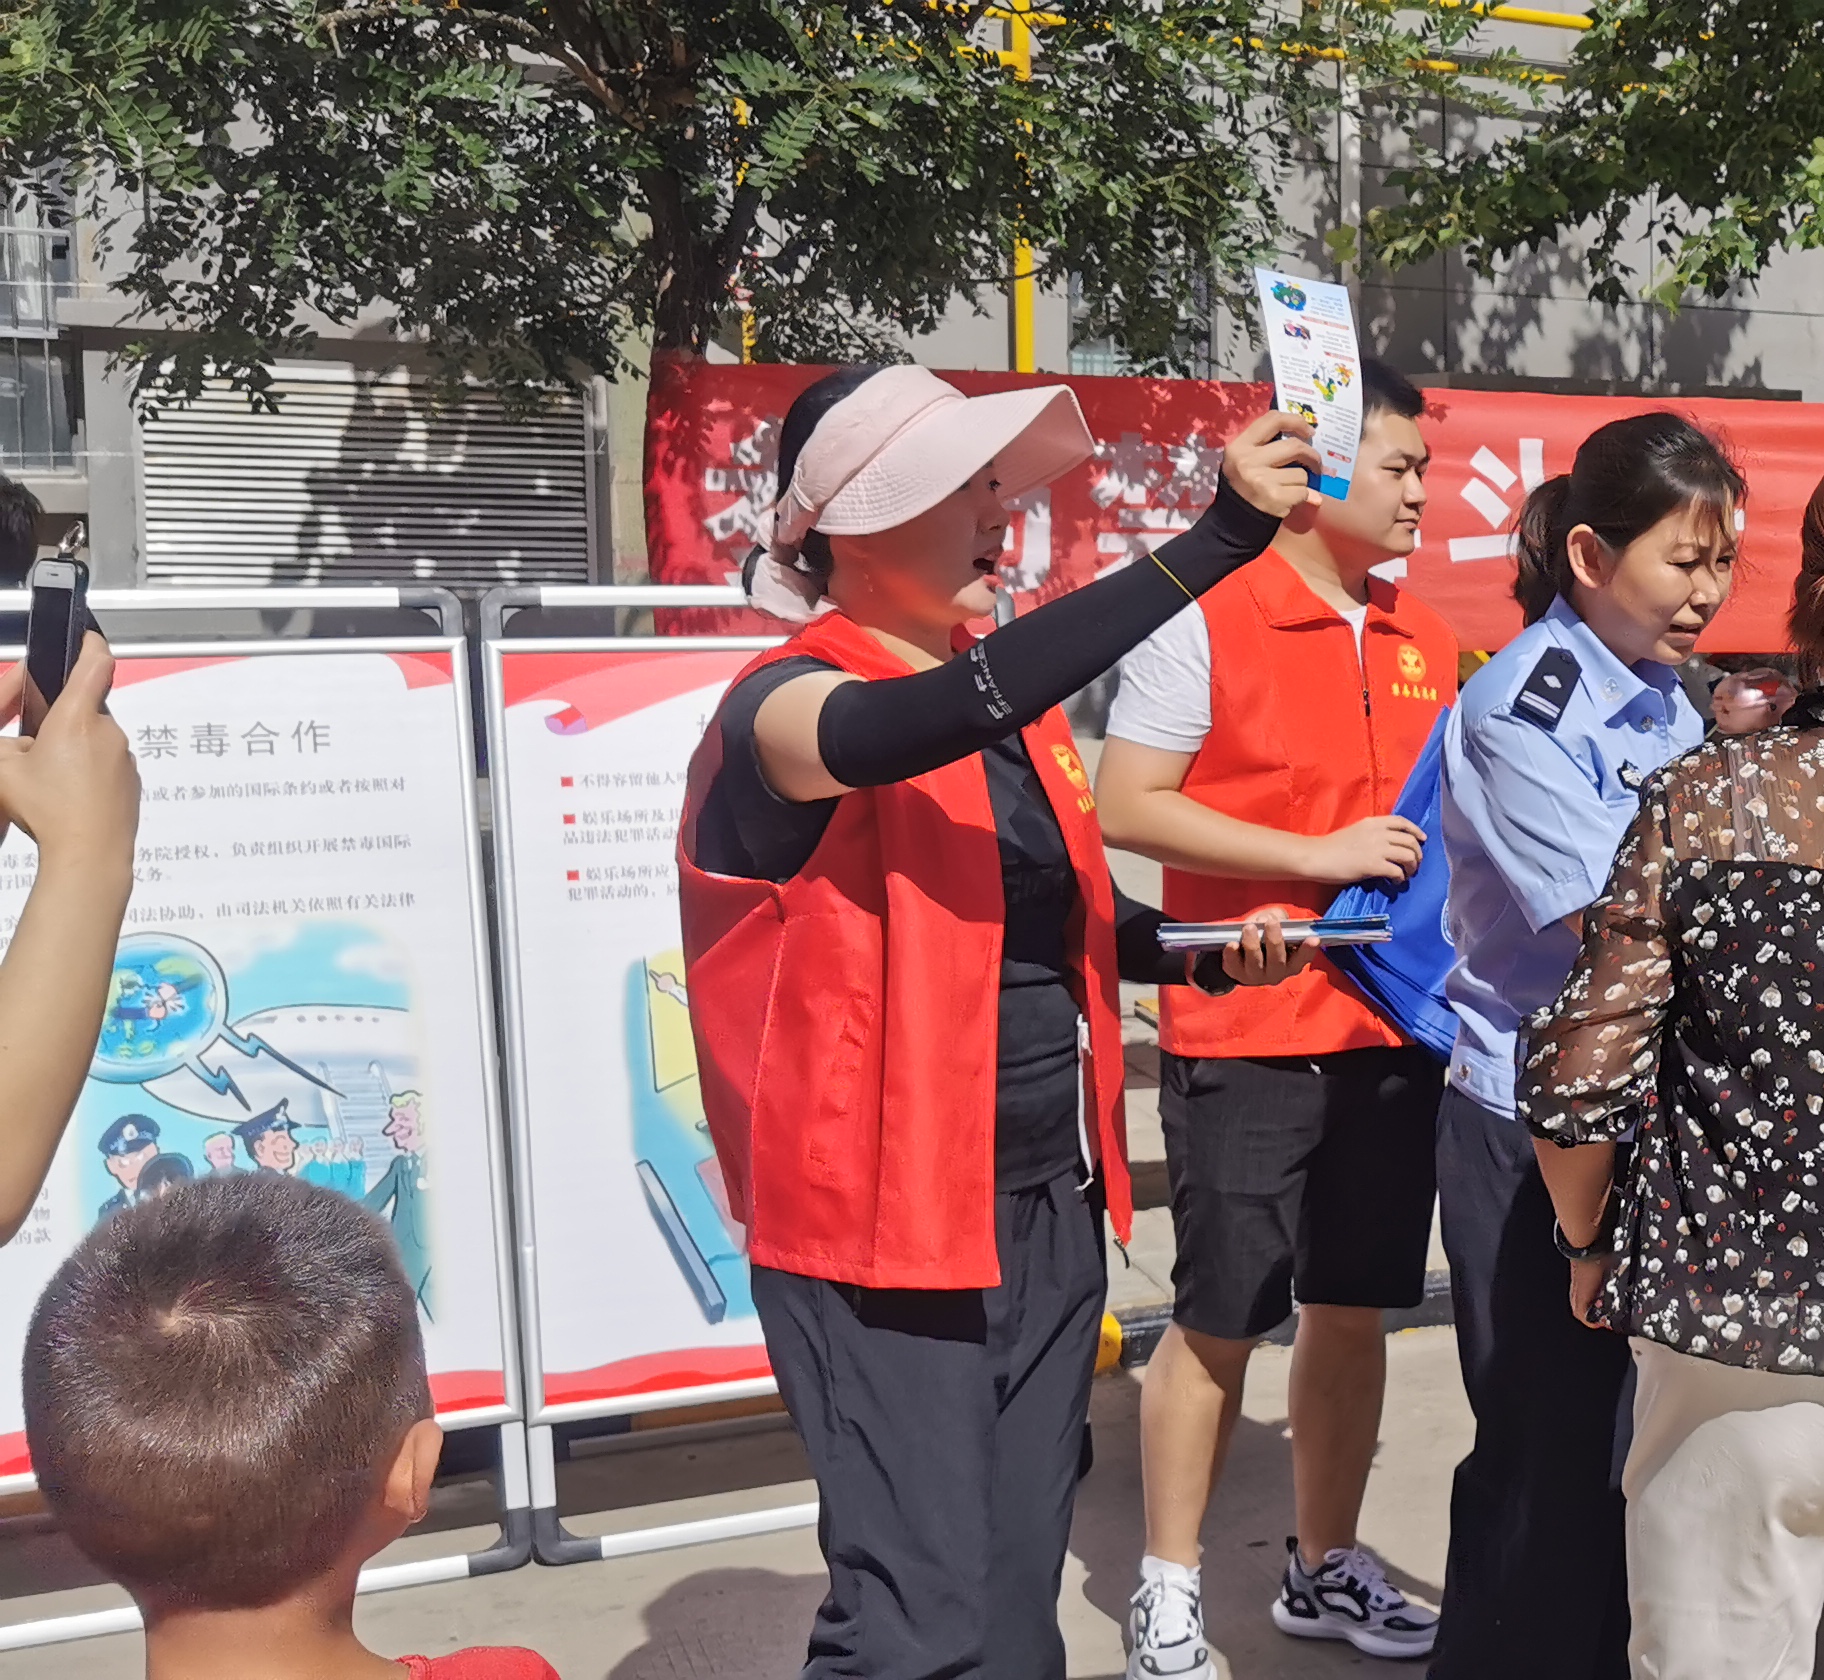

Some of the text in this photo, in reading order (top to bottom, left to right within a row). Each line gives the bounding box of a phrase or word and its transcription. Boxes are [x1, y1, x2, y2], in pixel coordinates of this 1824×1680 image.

[136, 719, 332, 760] 禁毒合作
[586, 863, 677, 881] 娱乐场所应
